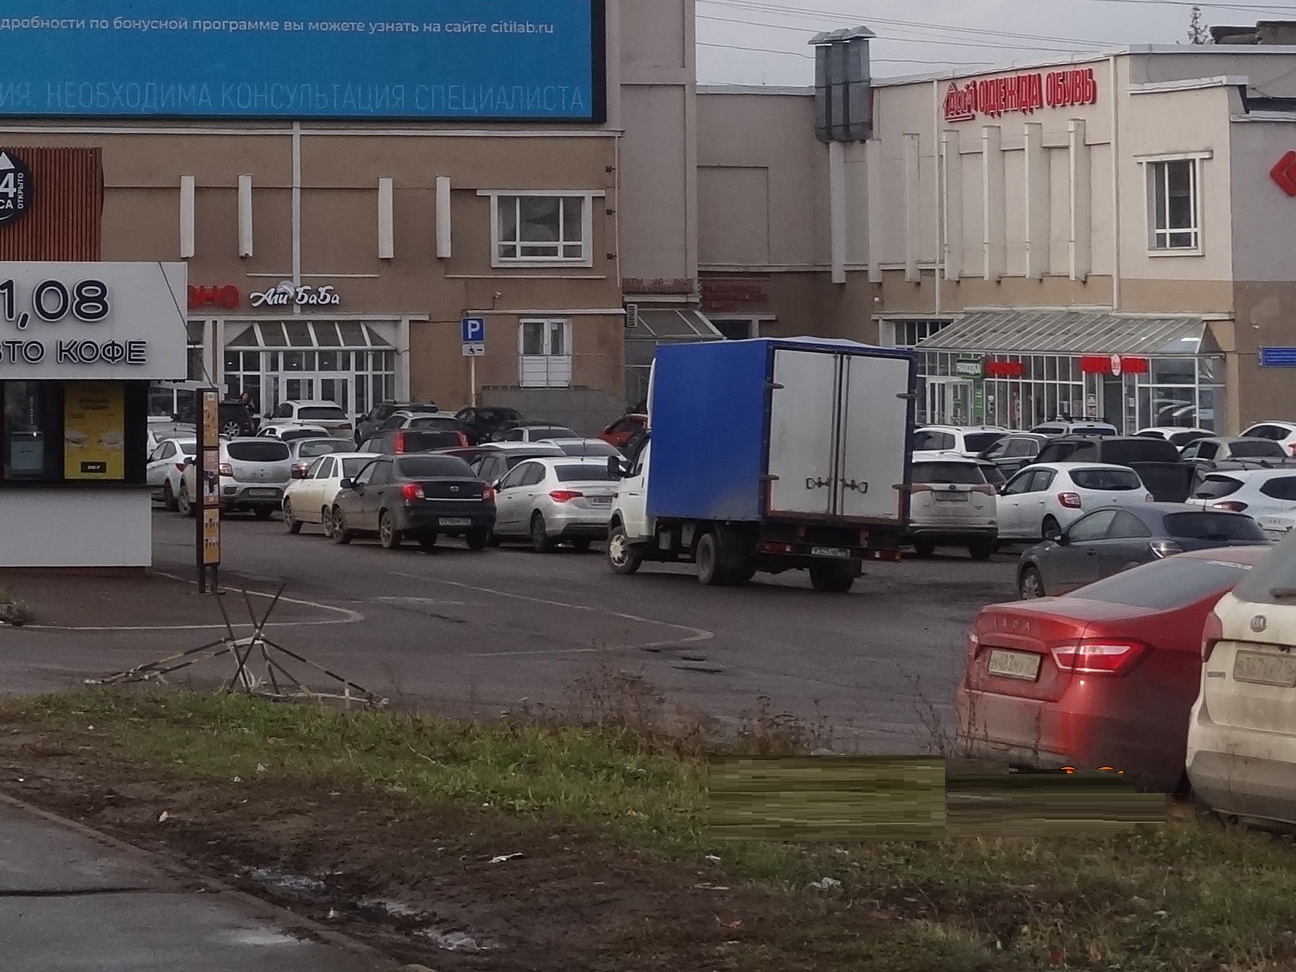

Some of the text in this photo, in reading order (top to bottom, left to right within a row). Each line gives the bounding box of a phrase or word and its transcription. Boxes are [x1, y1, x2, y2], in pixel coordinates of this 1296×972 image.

[89, 18, 109, 30] по
[113, 16, 188, 32] бонусной
[192, 18, 280, 33] программе
[284, 20, 304, 31] вы
[308, 20, 366, 32] можете
[368, 21, 419, 34] узнать
[423, 22, 441, 33] на
[445, 20, 487, 33] сайте
[490, 20, 554, 35] citilab.ru
[46, 81, 213, 112] НЕОБХОДИМА
[221, 83, 405, 112] КОНСУЛЬТАЦИЯ
[414, 84, 585, 113] СПЕЦИАЛИСТА
[978, 74, 1044, 118] ОДЕЖДА
[1046, 68, 1097, 108] ОБУВЬ
[250, 287, 289, 308] Али
[468, 320, 481, 339] P
[57, 339, 147, 364] КОФЕ
